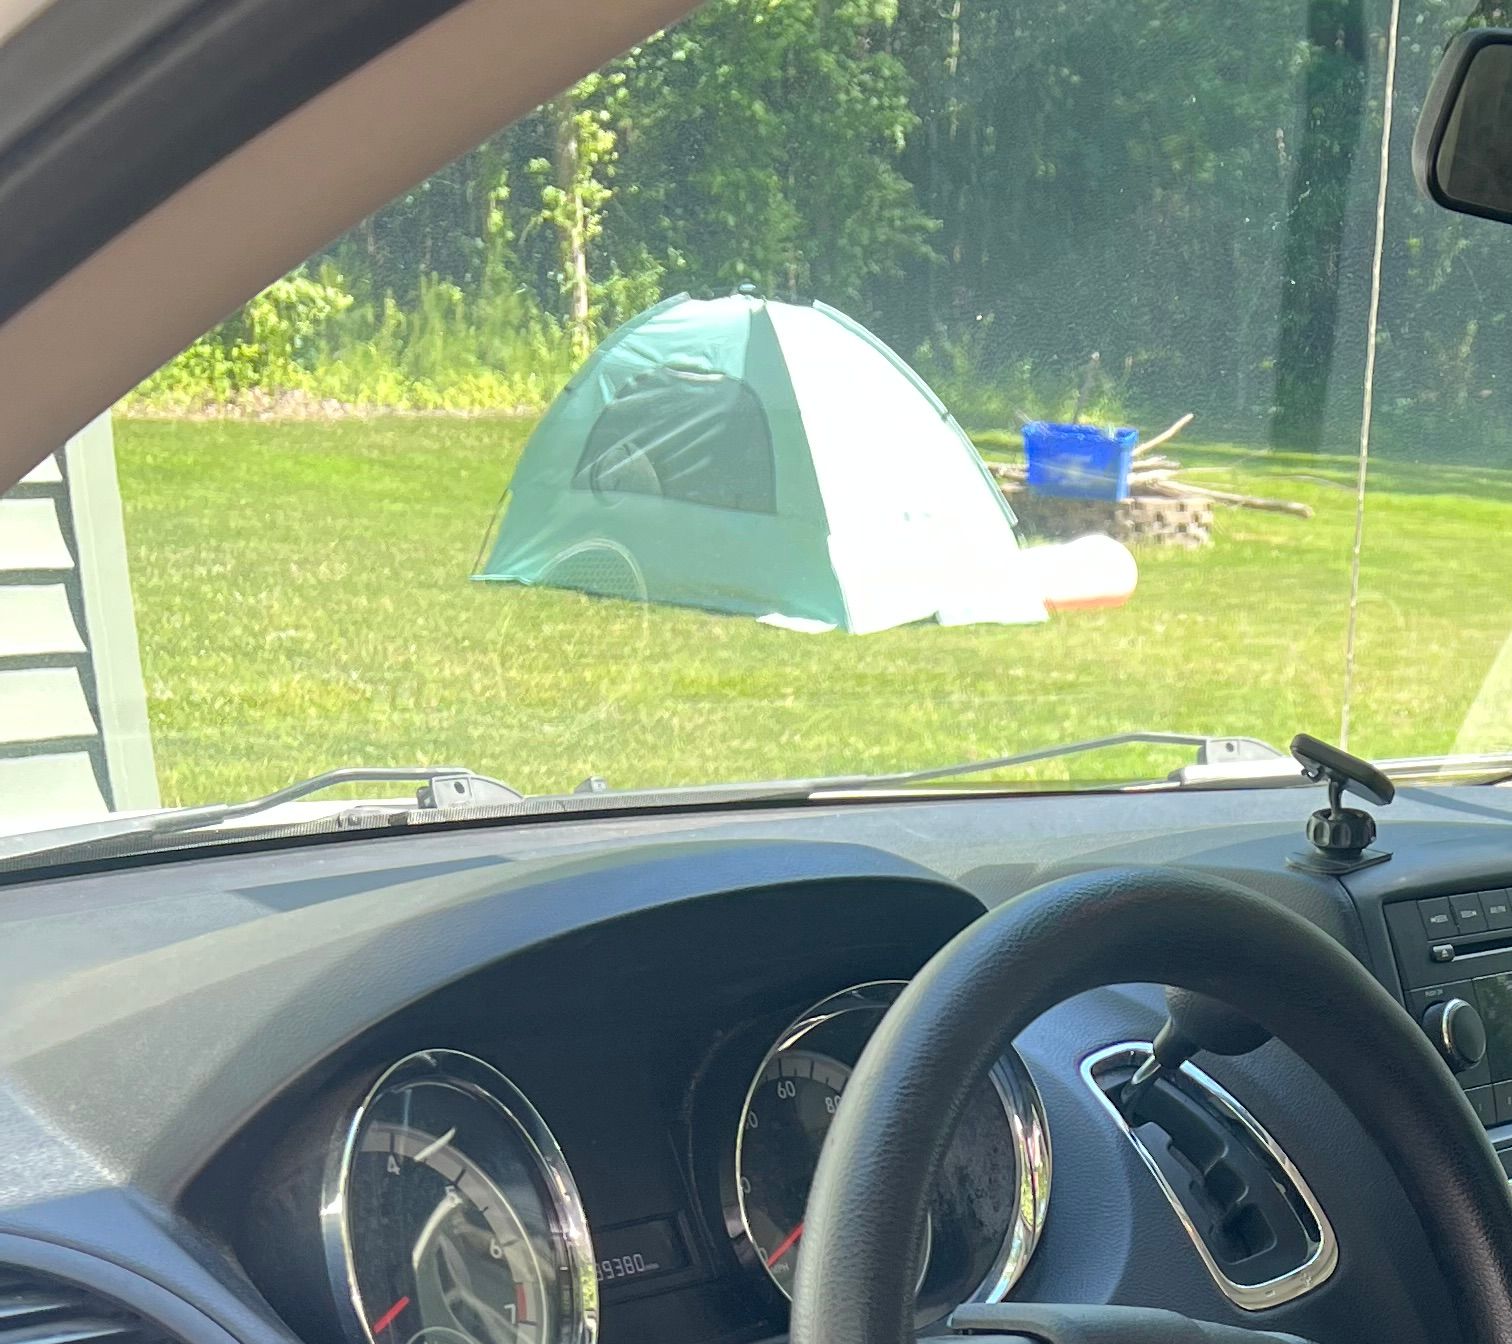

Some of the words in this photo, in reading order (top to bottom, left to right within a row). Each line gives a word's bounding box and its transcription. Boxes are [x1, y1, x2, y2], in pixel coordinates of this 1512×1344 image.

[777, 1080, 796, 1099] 60
[387, 1155, 400, 1176] 4
[489, 1239, 503, 1260] 6
[504, 1304, 518, 1326] 7
